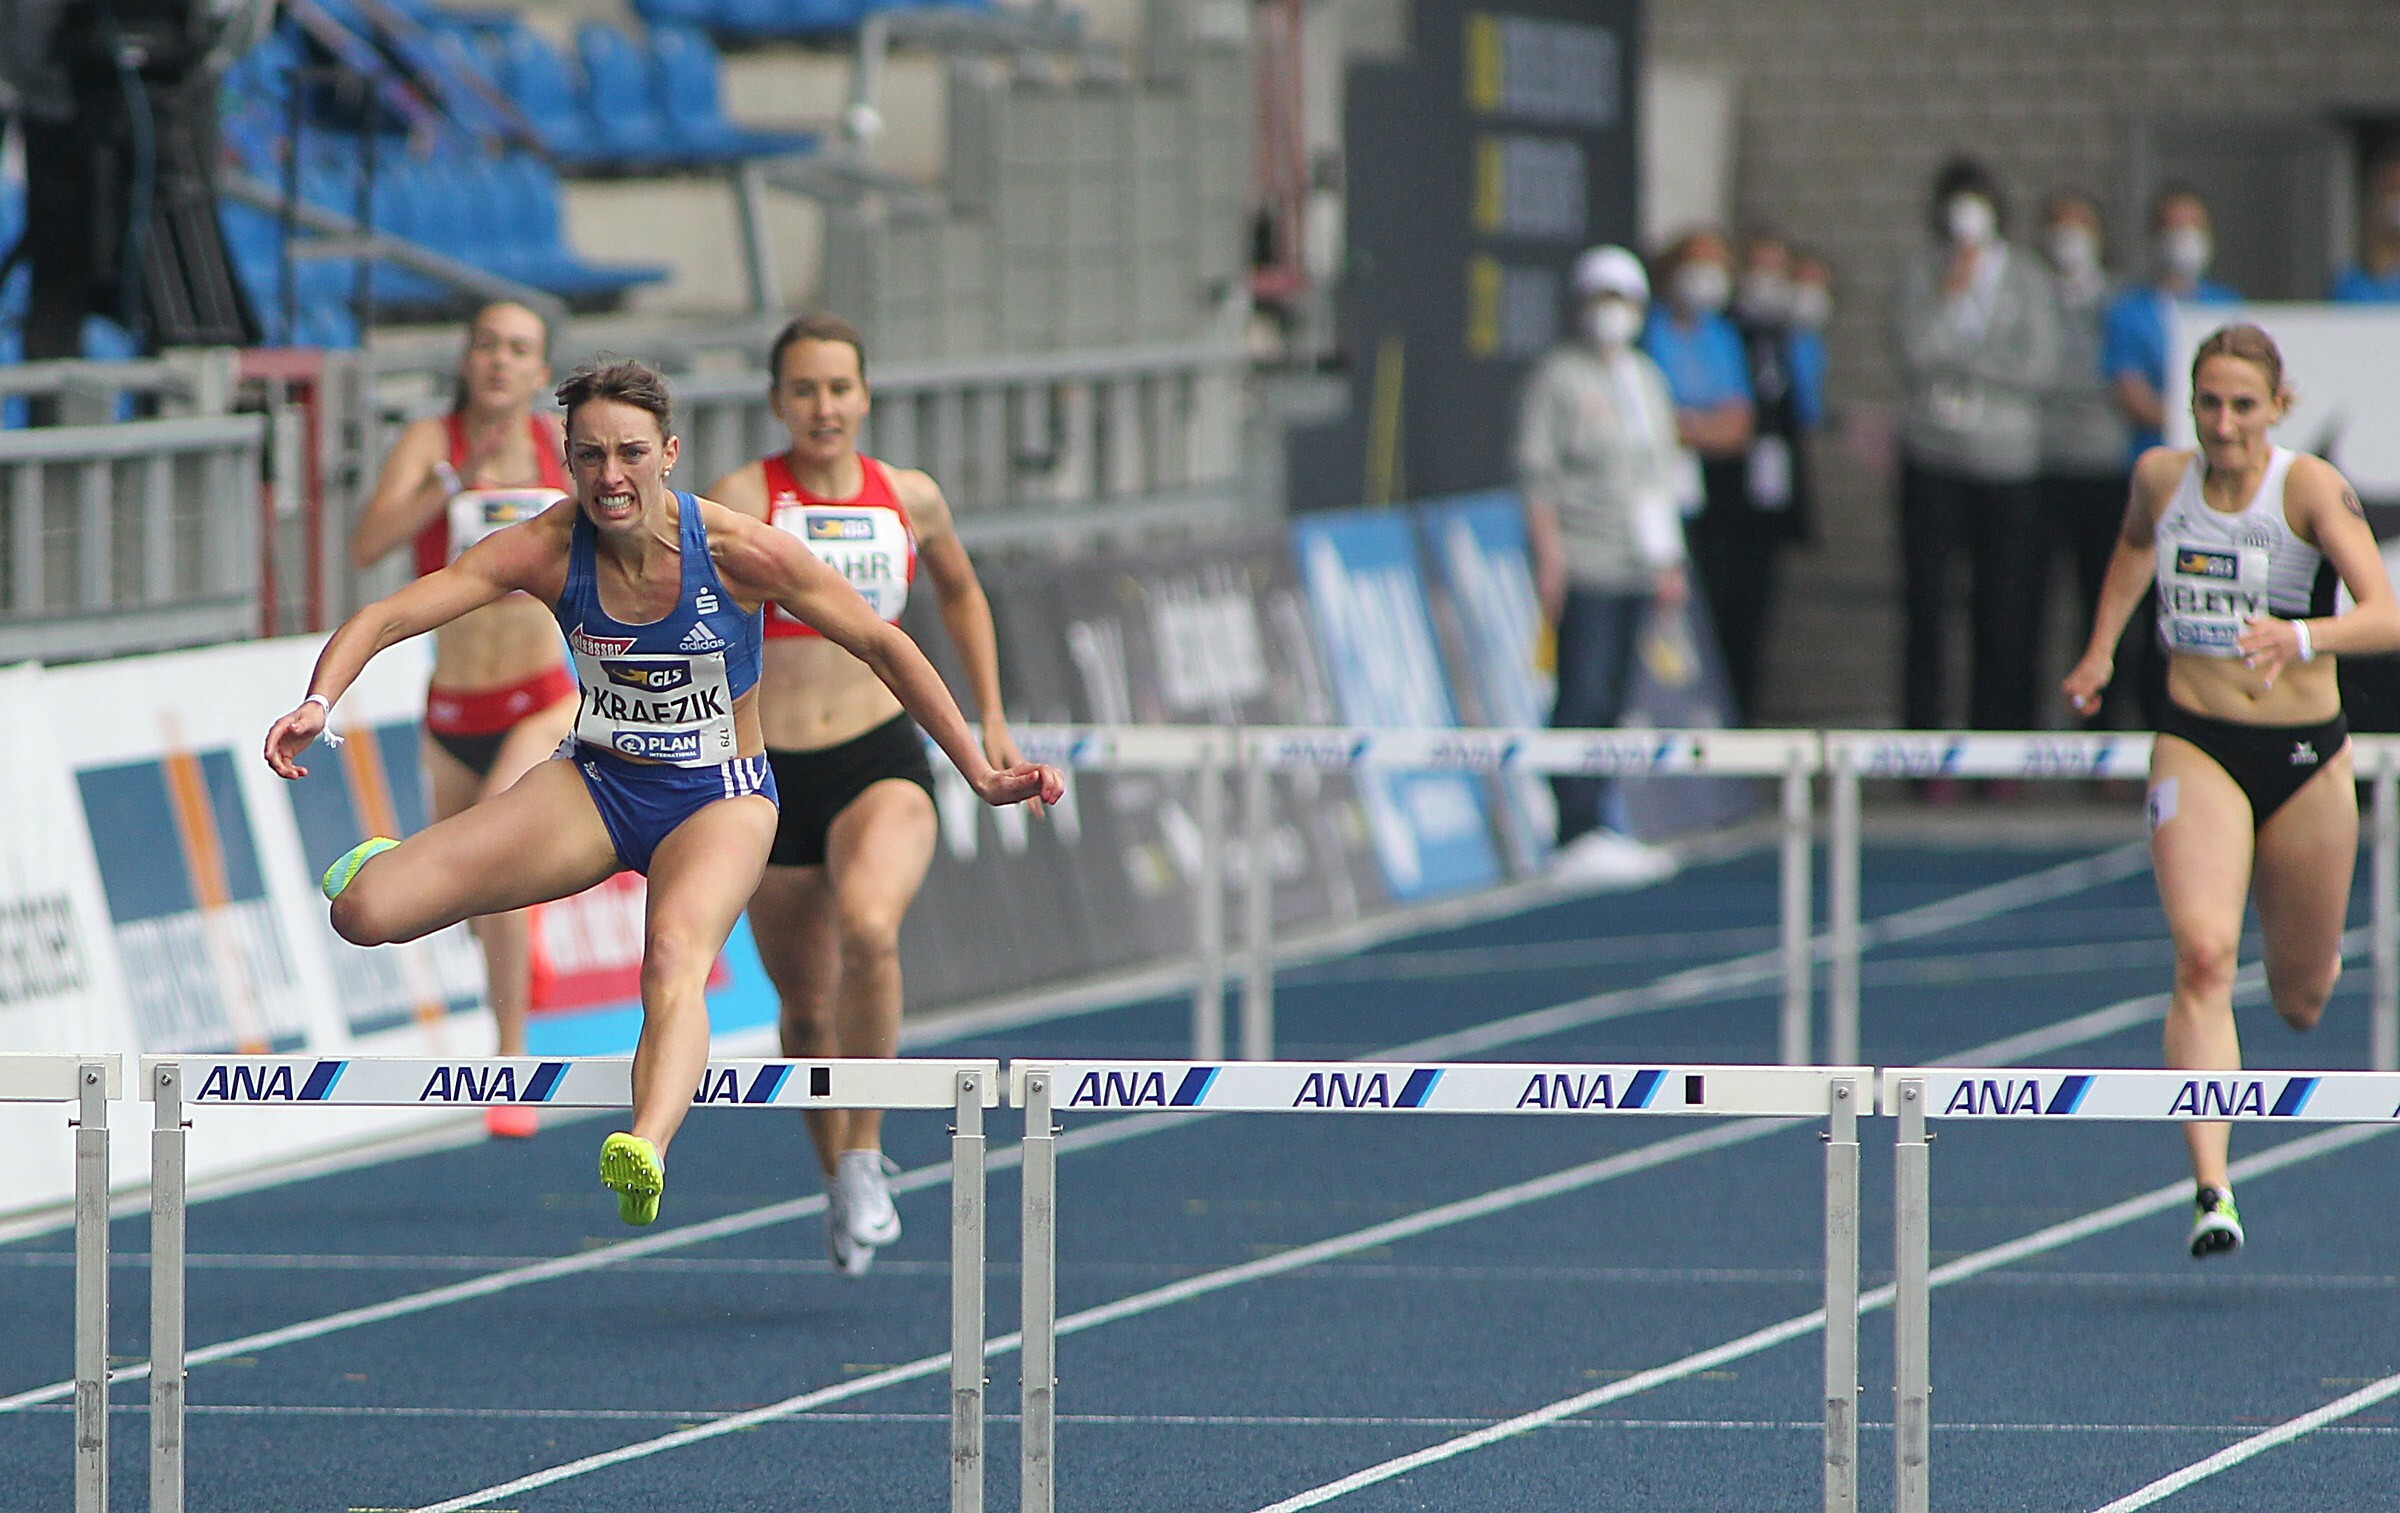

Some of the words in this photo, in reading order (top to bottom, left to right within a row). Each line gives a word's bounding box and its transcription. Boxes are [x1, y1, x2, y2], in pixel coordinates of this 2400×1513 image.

[679, 638, 726, 651] adidas
[648, 668, 683, 687] GLS
[648, 735, 697, 751] PLAN
[719, 727, 731, 748] 179
[649, 750, 698, 758] INTERNATIONAL
[197, 1065, 295, 1101] ANA
[420, 1066, 517, 1102] ANA
[1069, 1071, 1166, 1107] ANA
[1292, 1072, 1391, 1109] ANA
[1515, 1073, 1615, 1110] ANA
[1945, 1079, 2042, 1115] ANA
[2168, 1080, 2268, 1116] ANA
